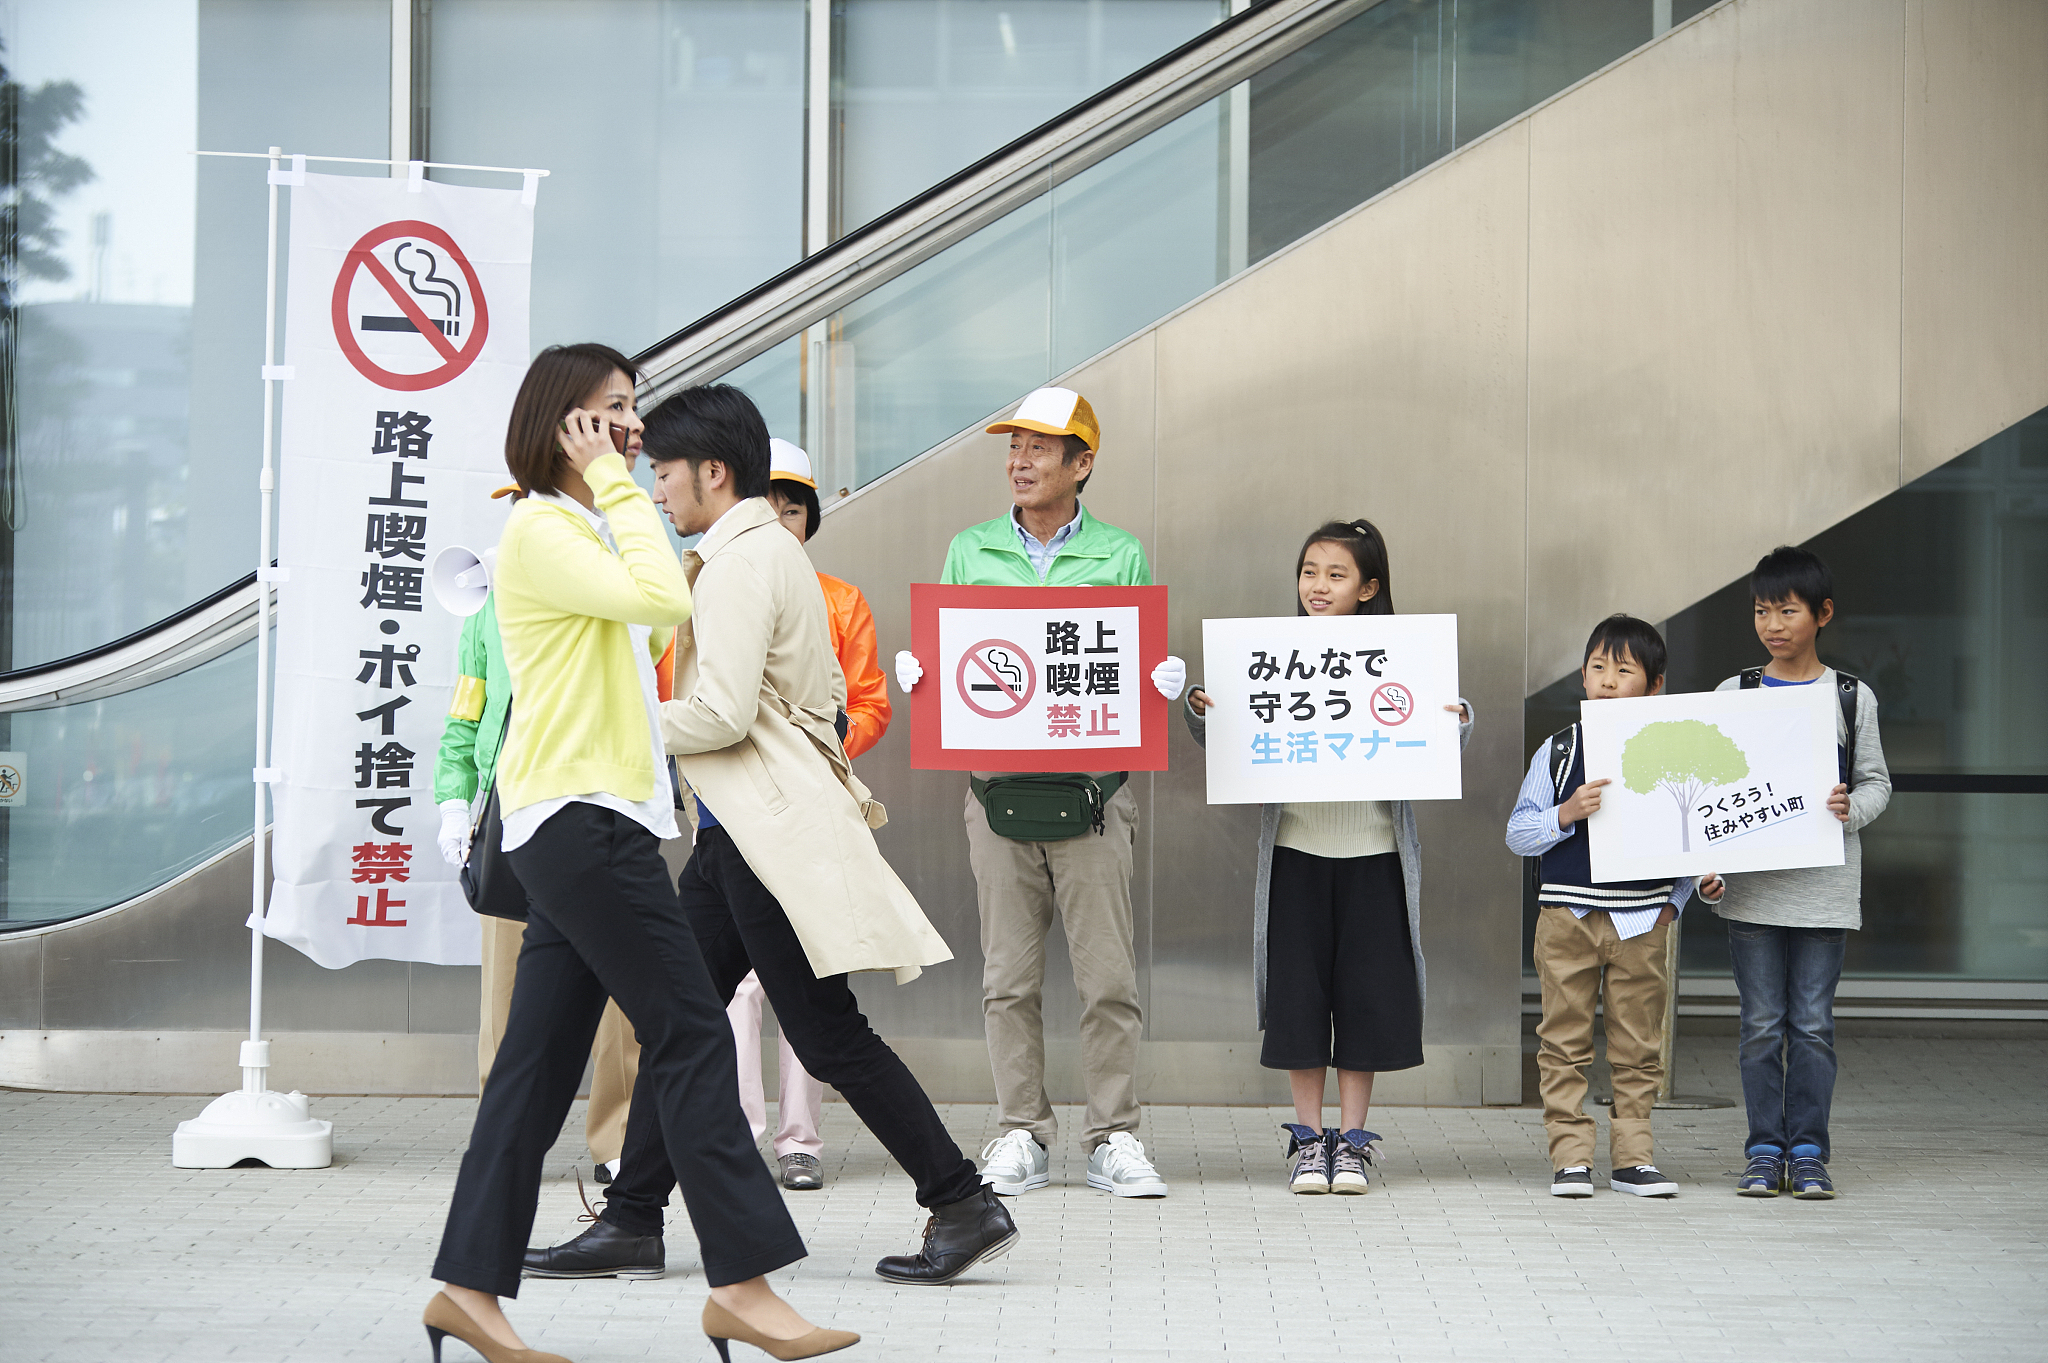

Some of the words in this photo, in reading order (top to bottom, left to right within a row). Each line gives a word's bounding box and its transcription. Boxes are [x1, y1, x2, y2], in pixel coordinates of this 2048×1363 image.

[1044, 620, 1119, 656] 路上
[347, 410, 434, 928] 路上喫煙・ポイ捨て禁止
[1045, 661, 1120, 697] 喫煙
[1248, 648, 1389, 682] みんなで
[1046, 703, 1121, 738] 禁止
[1249, 689, 1353, 724] 守ろう
[1250, 730, 1427, 765] 生活マナー
[1704, 795, 1806, 842] 住みやすい町
